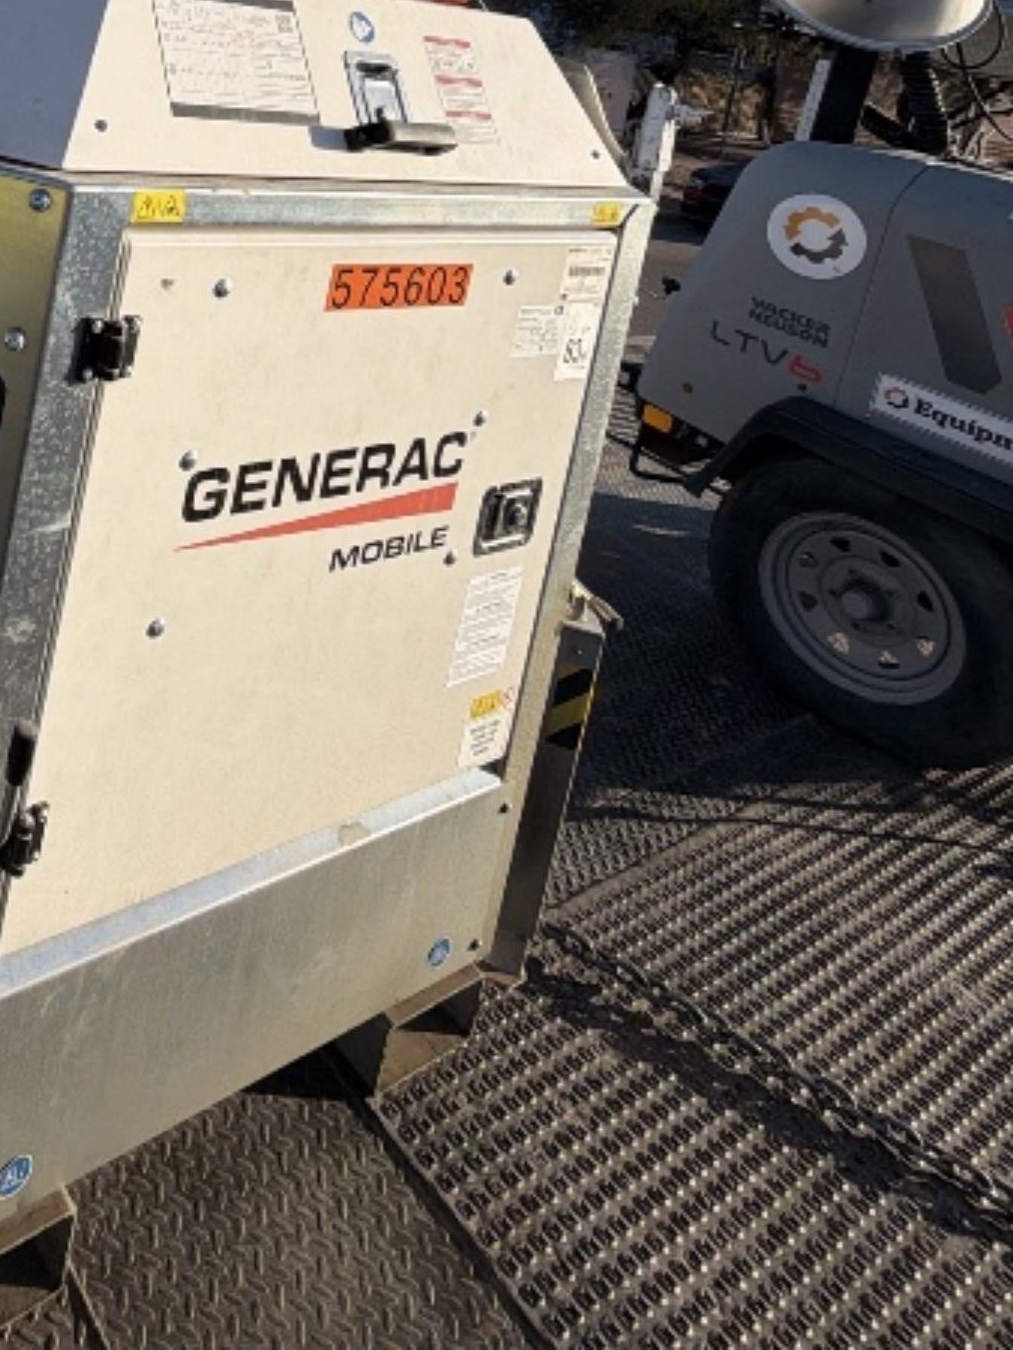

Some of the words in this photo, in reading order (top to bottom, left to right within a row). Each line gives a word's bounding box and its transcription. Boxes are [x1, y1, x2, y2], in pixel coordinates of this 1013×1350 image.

[331, 266, 468, 309] 575603
[749, 309, 828, 348] NEUSON
[752, 296, 829, 332] WACKER
[181, 431, 468, 523] GENERAC
[328, 526, 450, 572] MOBILE
